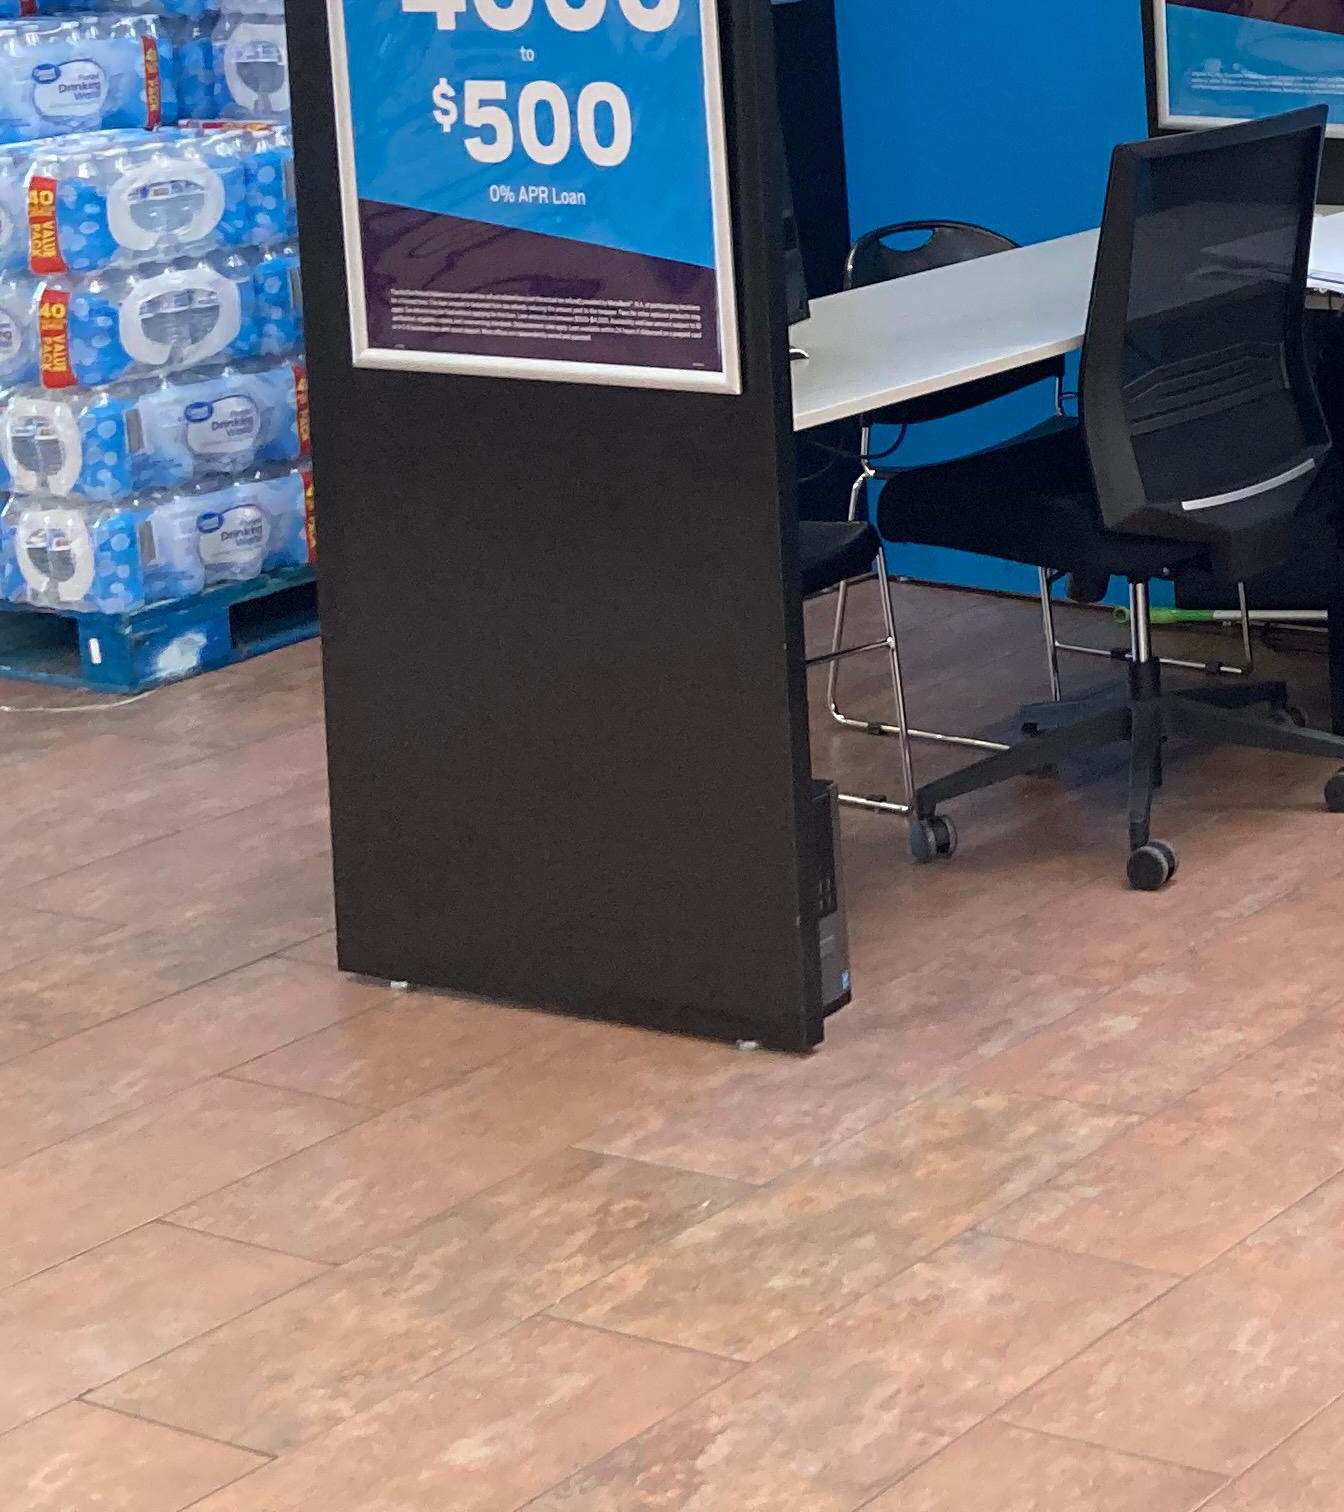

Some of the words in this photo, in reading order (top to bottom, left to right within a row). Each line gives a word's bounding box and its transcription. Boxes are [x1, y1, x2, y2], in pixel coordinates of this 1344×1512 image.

[520, 45, 535, 62] to
[432, 78, 632, 167] $500
[489, 184, 515, 204] 0%
[518, 186, 549, 204] APR
[552, 187, 587, 205] Loan
[41, 302, 66, 319] 40
